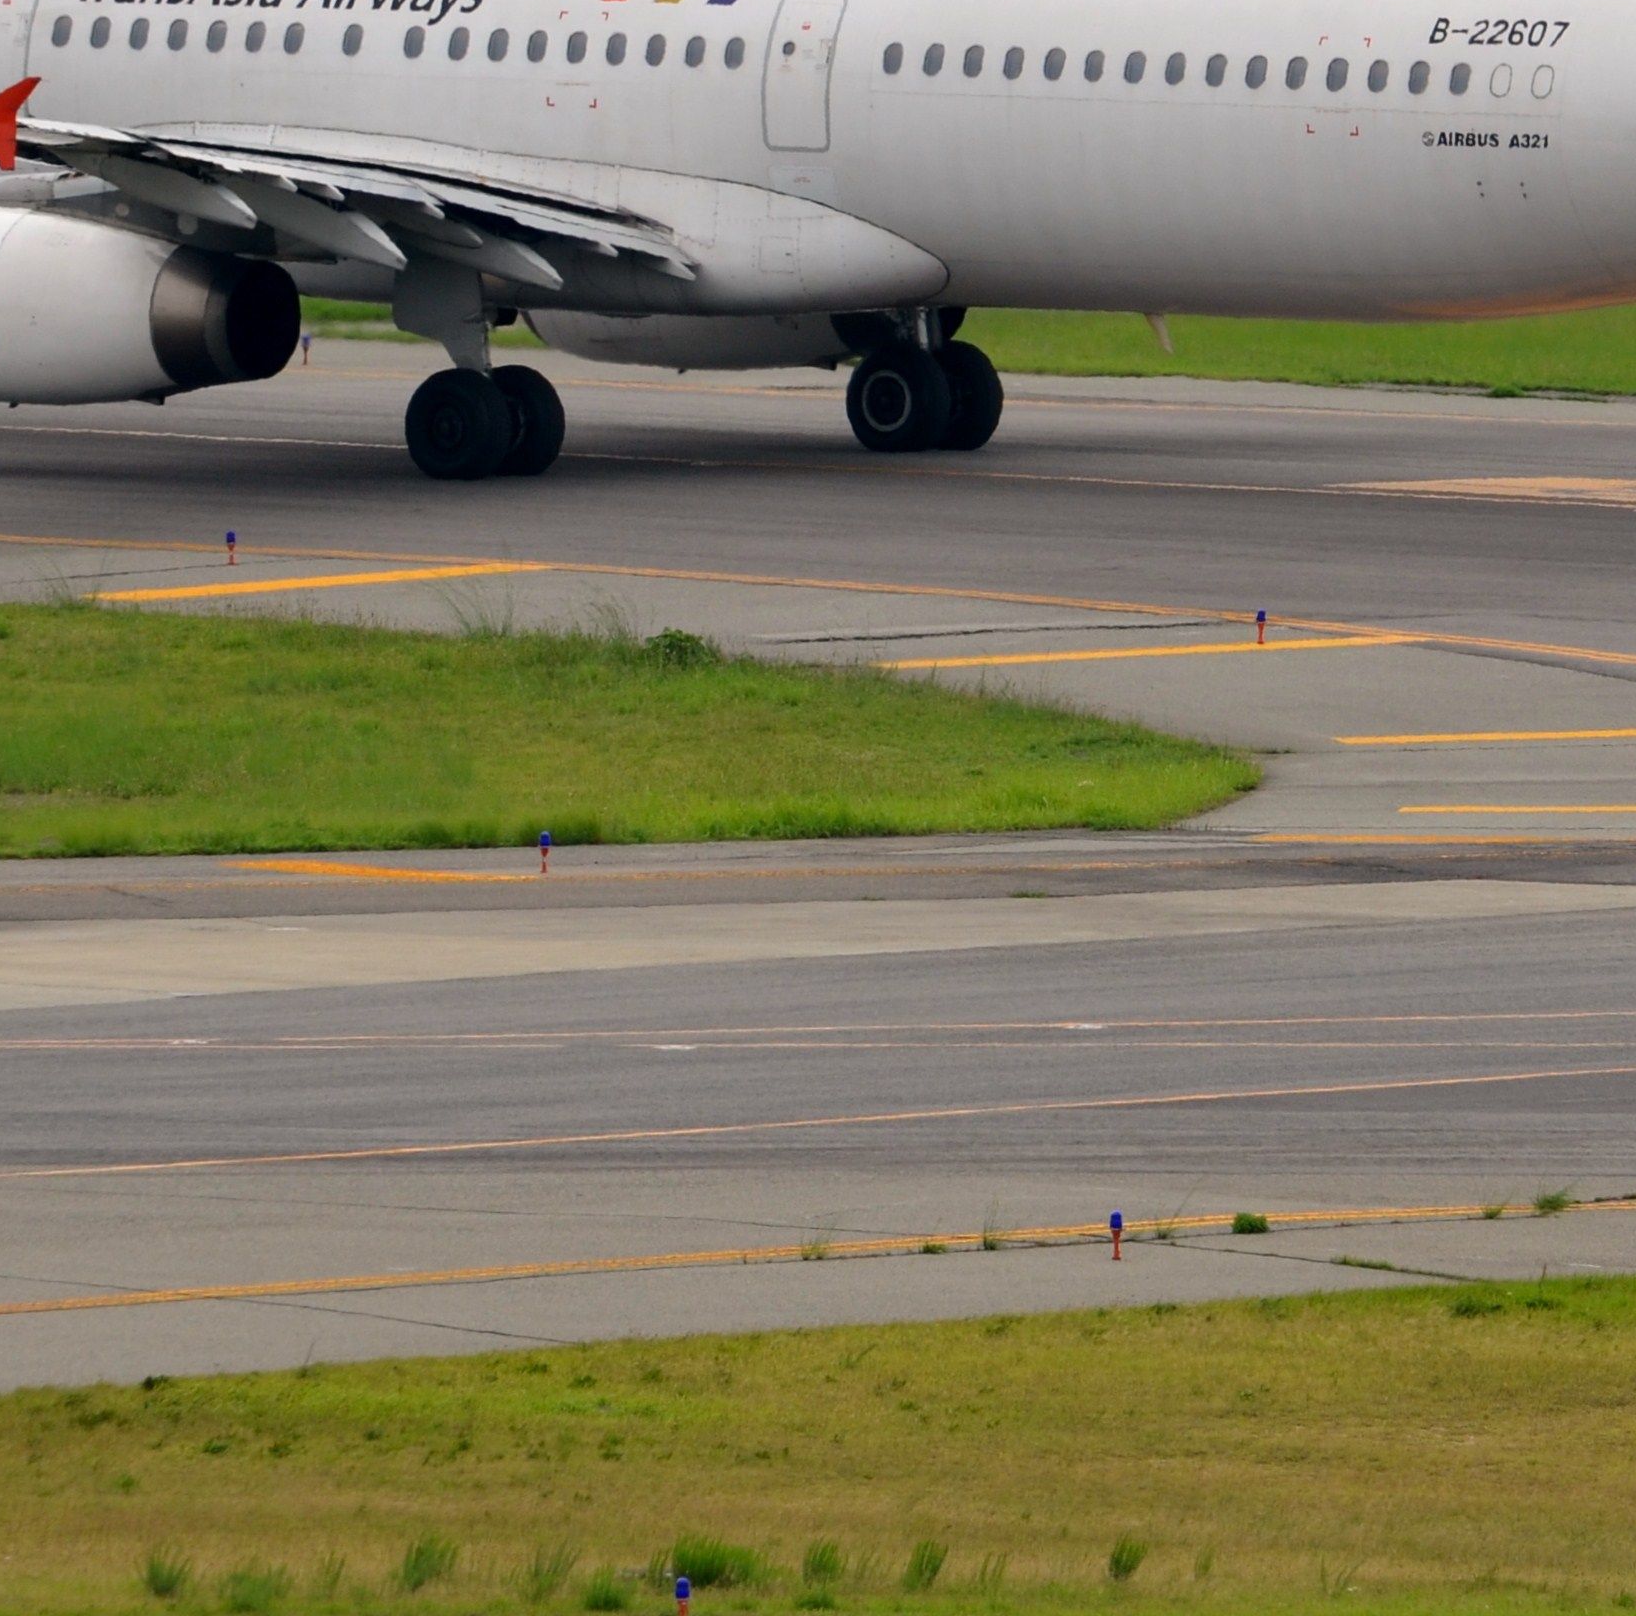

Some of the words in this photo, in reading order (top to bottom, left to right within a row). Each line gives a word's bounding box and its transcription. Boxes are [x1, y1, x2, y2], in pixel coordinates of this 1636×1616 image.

[1428, 17, 1570, 47] B-22607
[1436, 131, 1500, 148] AIRBUS
[1508, 134, 1549, 149] A321
